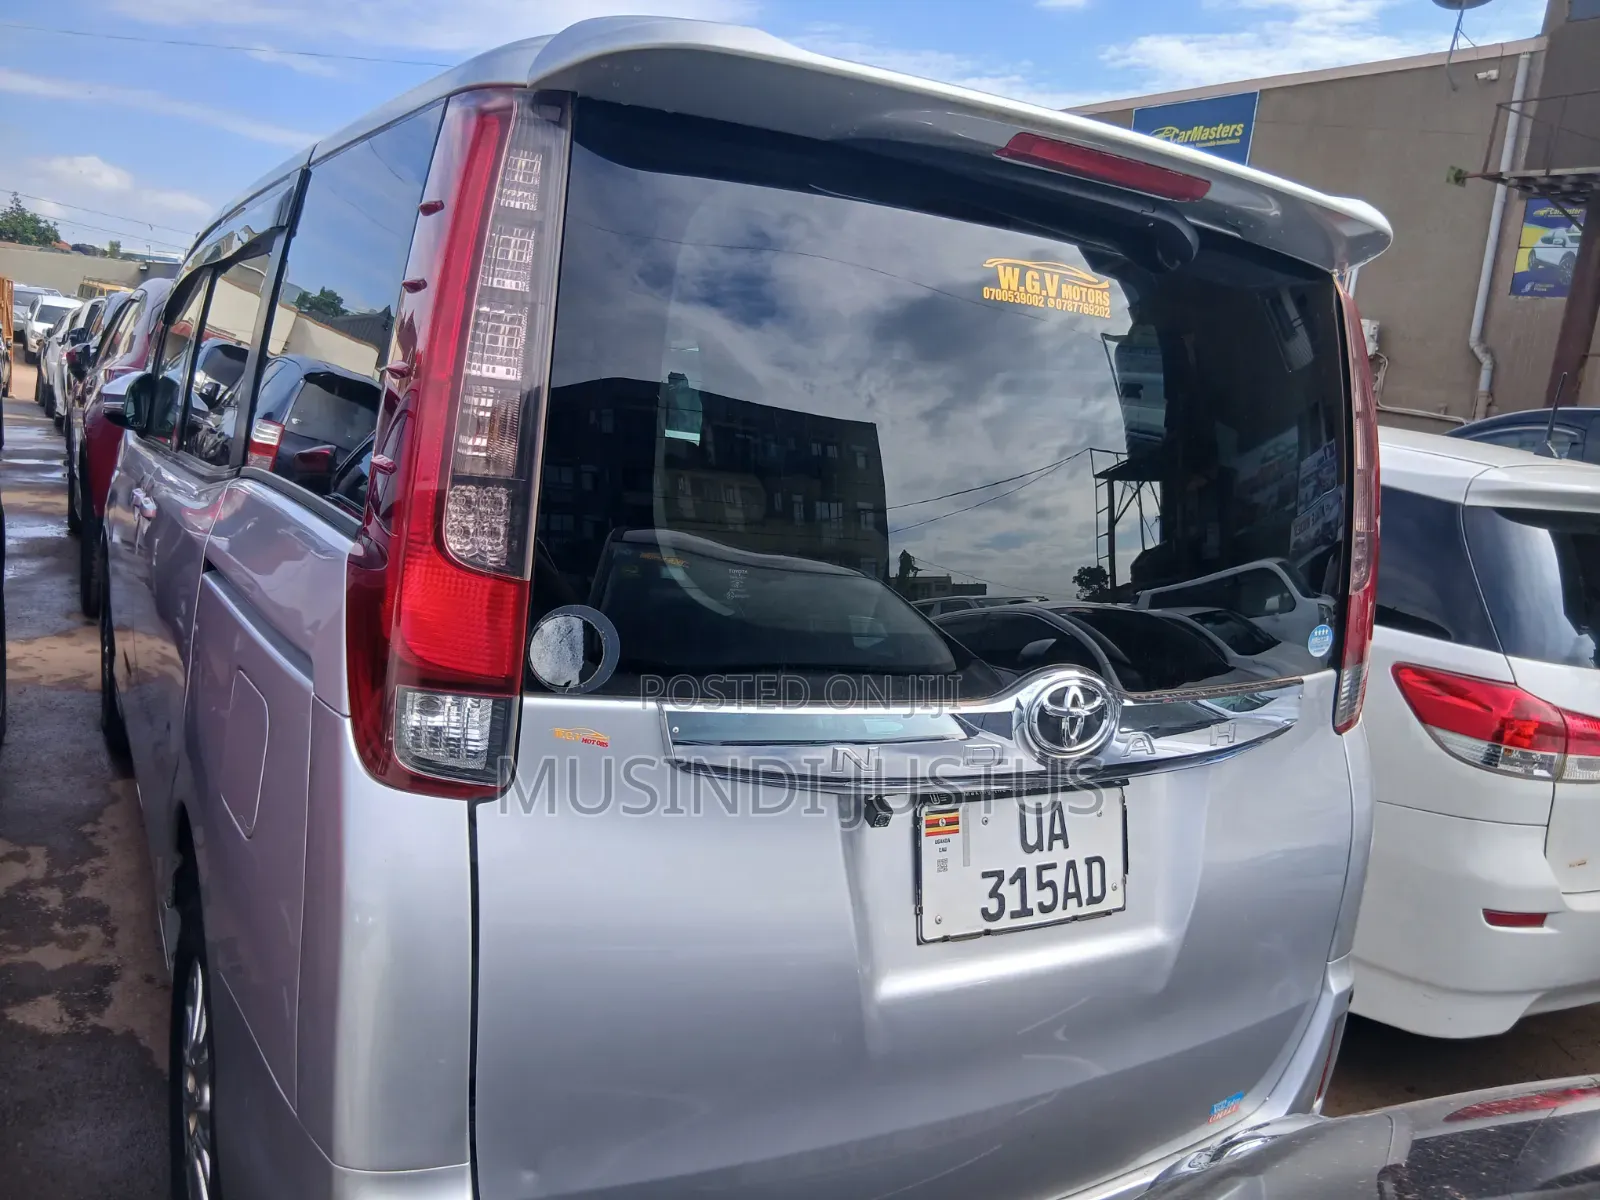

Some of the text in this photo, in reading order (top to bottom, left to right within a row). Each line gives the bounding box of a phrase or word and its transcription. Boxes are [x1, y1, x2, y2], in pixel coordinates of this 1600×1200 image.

[1169, 123, 1245, 143] CarMasters
[997, 265, 1111, 307] W.G.V MOTORS
[581, 738, 609, 748] MOTORS
[1019, 801, 1069, 854] UA
[980, 855, 1106, 922] 315AD
